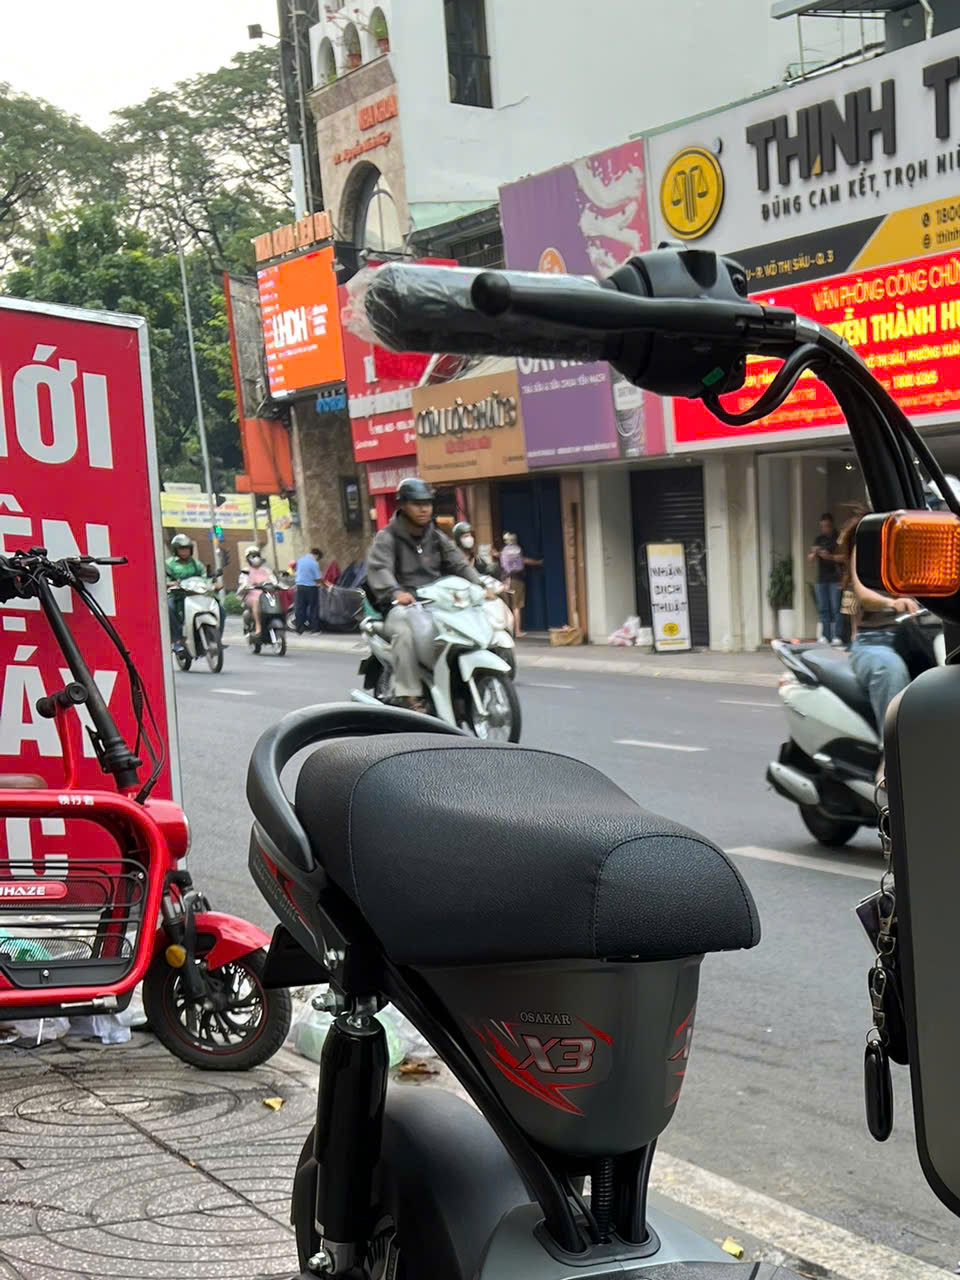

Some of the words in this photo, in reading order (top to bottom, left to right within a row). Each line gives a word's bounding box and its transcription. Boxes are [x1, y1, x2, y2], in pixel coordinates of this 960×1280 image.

[809, 180, 840, 209] CAM
[884, 159, 928, 189] TRỌN
[870, 302, 937, 343] THÀNH
[0, 343, 113, 469] ỚI
[0, 886, 45, 896] HAZE
[520, 1011, 572, 1025] OSAKAR
[515, 1033, 596, 1074] X3
